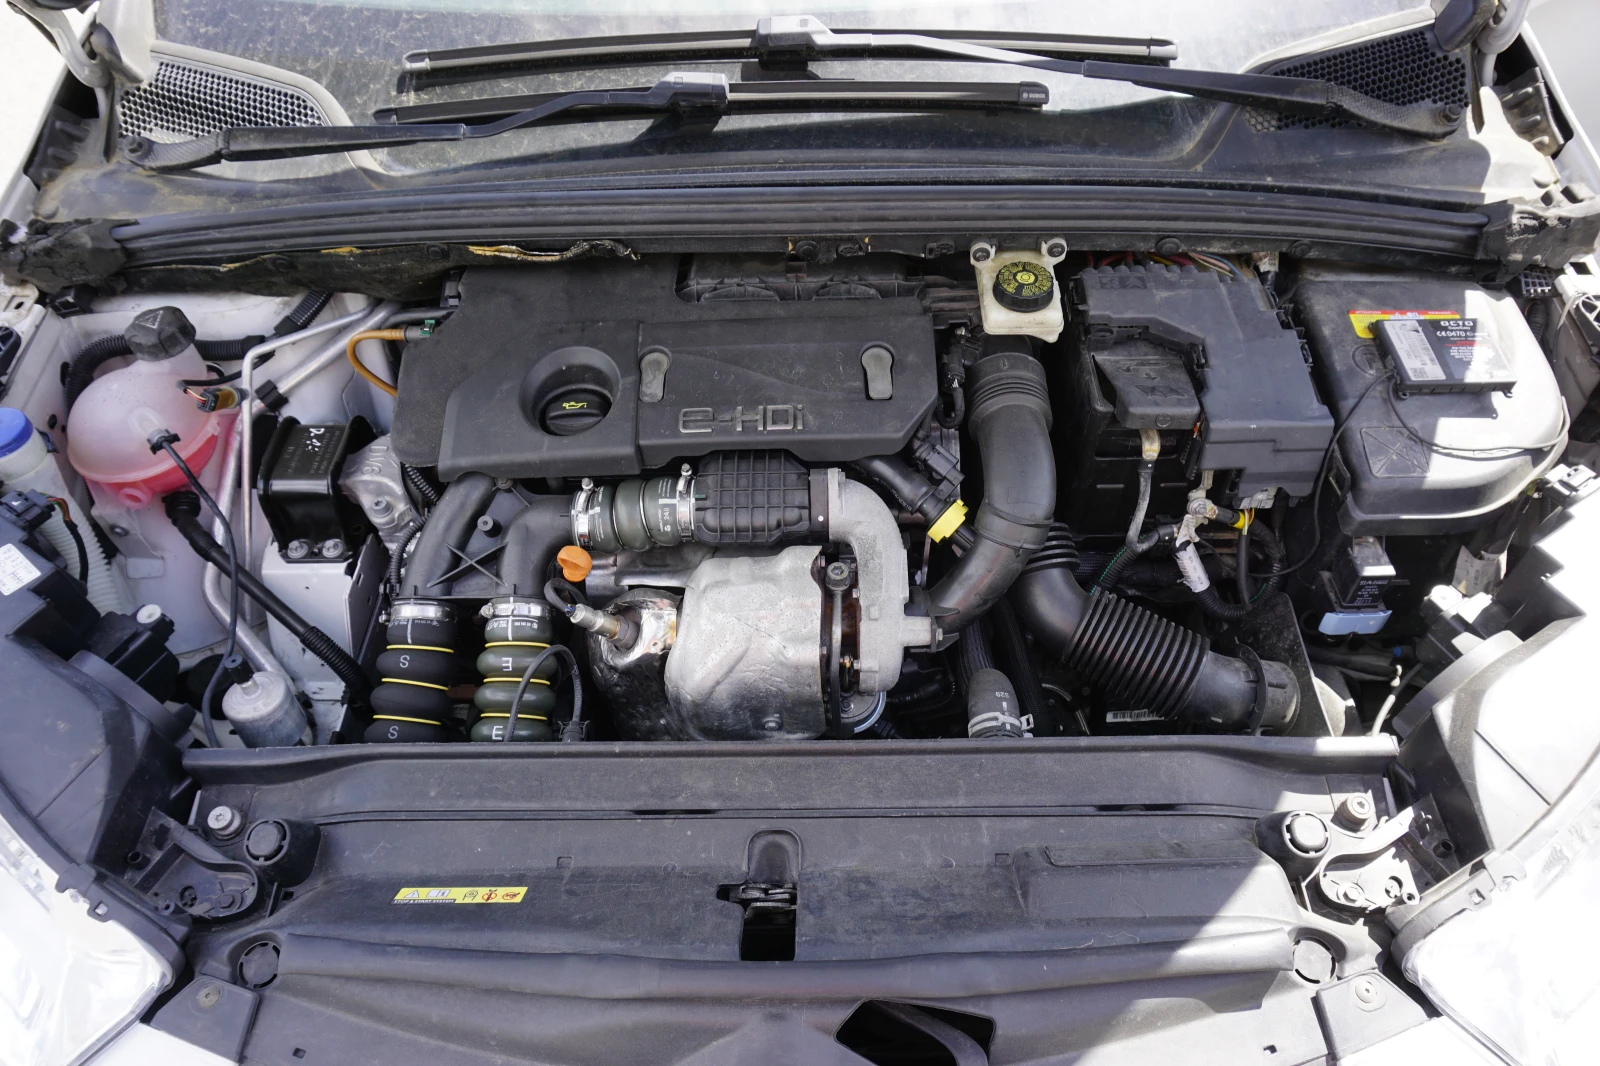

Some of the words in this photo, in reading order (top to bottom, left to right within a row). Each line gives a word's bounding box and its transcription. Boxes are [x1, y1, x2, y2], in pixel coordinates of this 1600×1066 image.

[400, 654, 410, 668] S
[502, 657, 512, 672] E
[388, 725, 399, 740] S
[492, 726, 504, 740] E
